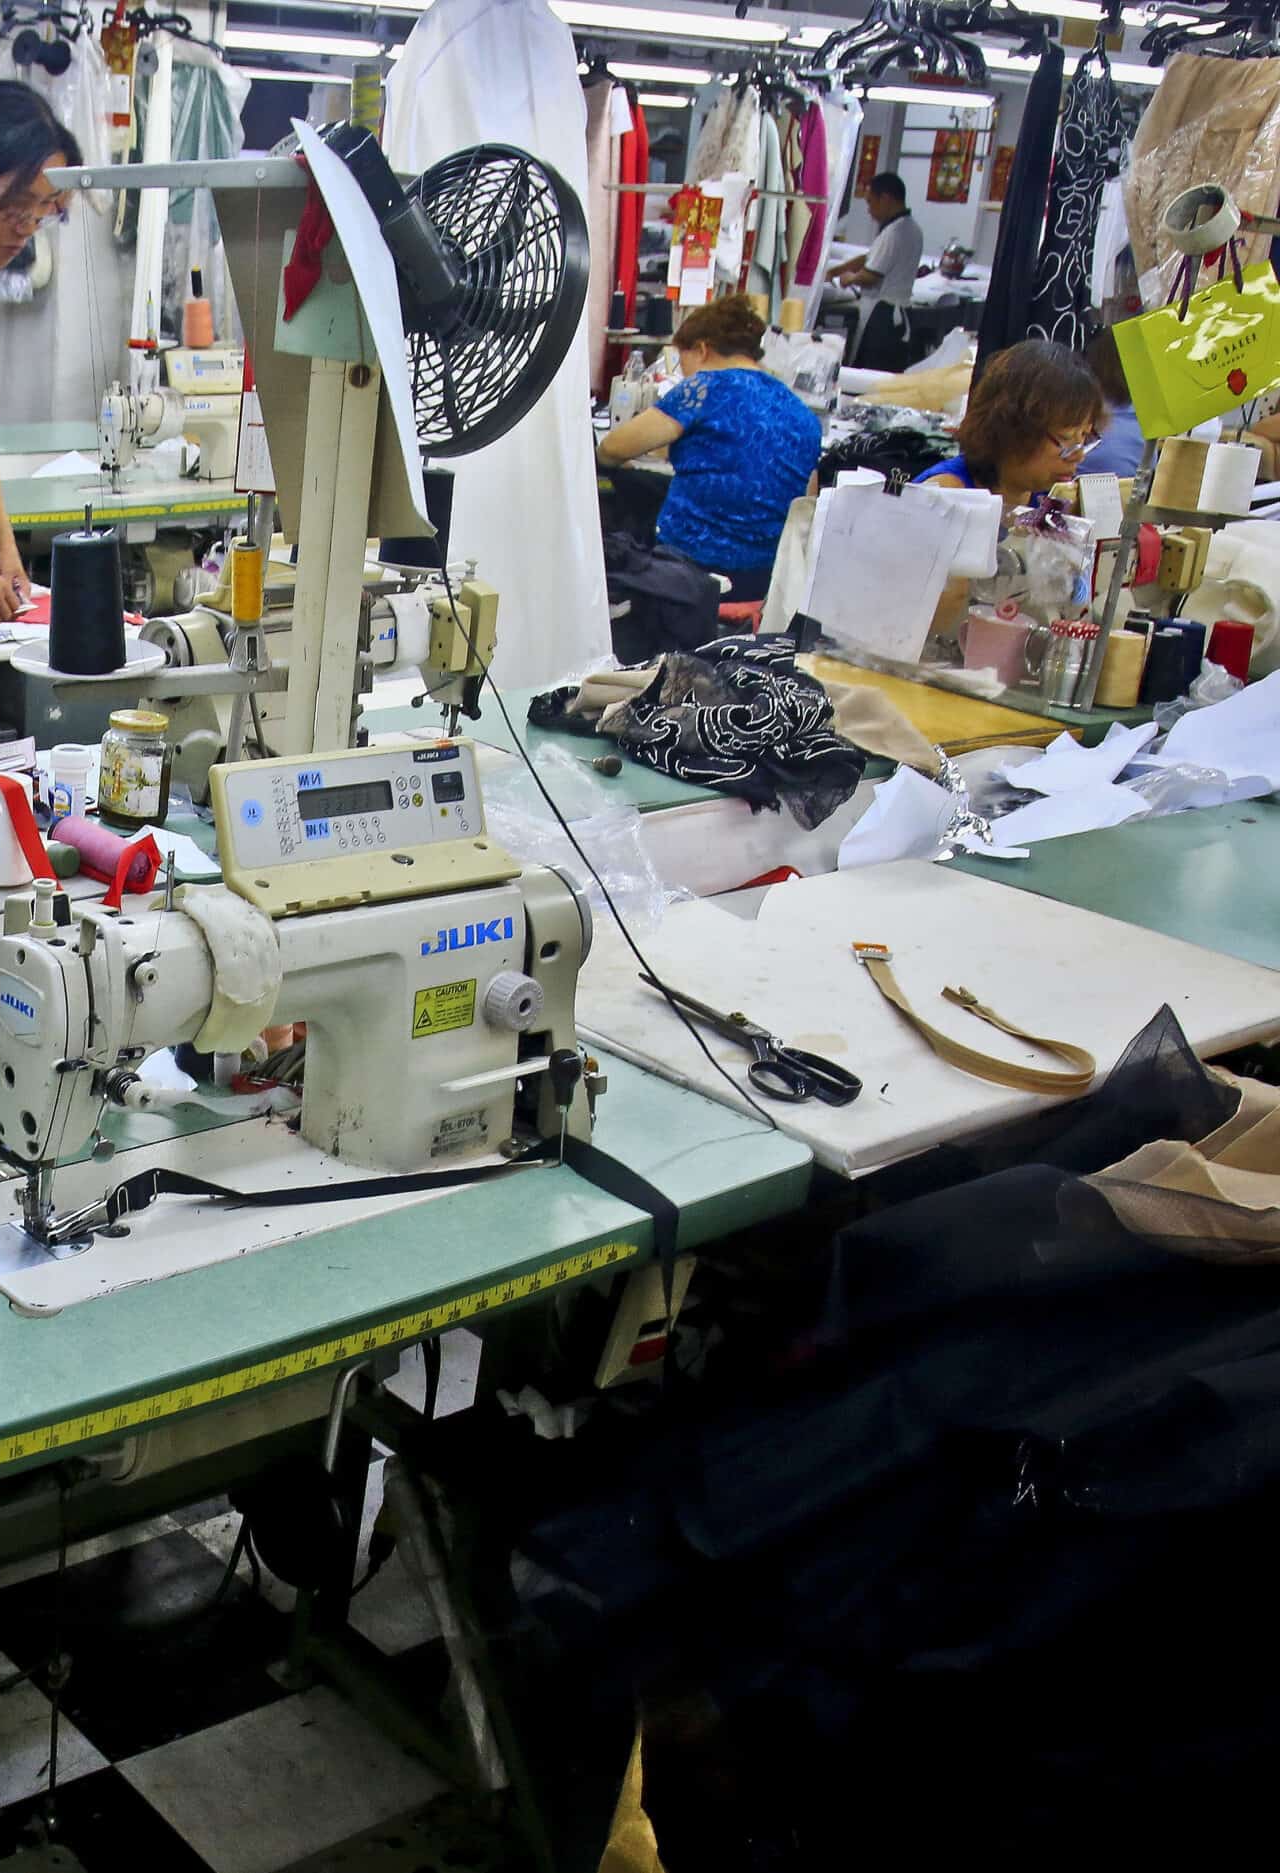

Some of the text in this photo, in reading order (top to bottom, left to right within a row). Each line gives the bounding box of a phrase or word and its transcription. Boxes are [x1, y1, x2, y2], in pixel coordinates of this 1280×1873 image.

[1197, 333, 1257, 368] TED BAKER
[417, 751, 439, 761] JUKI
[420, 916, 514, 957] JUKI
[435, 983, 468, 997] CAUTION
[0, 993, 34, 1019] JUKI
